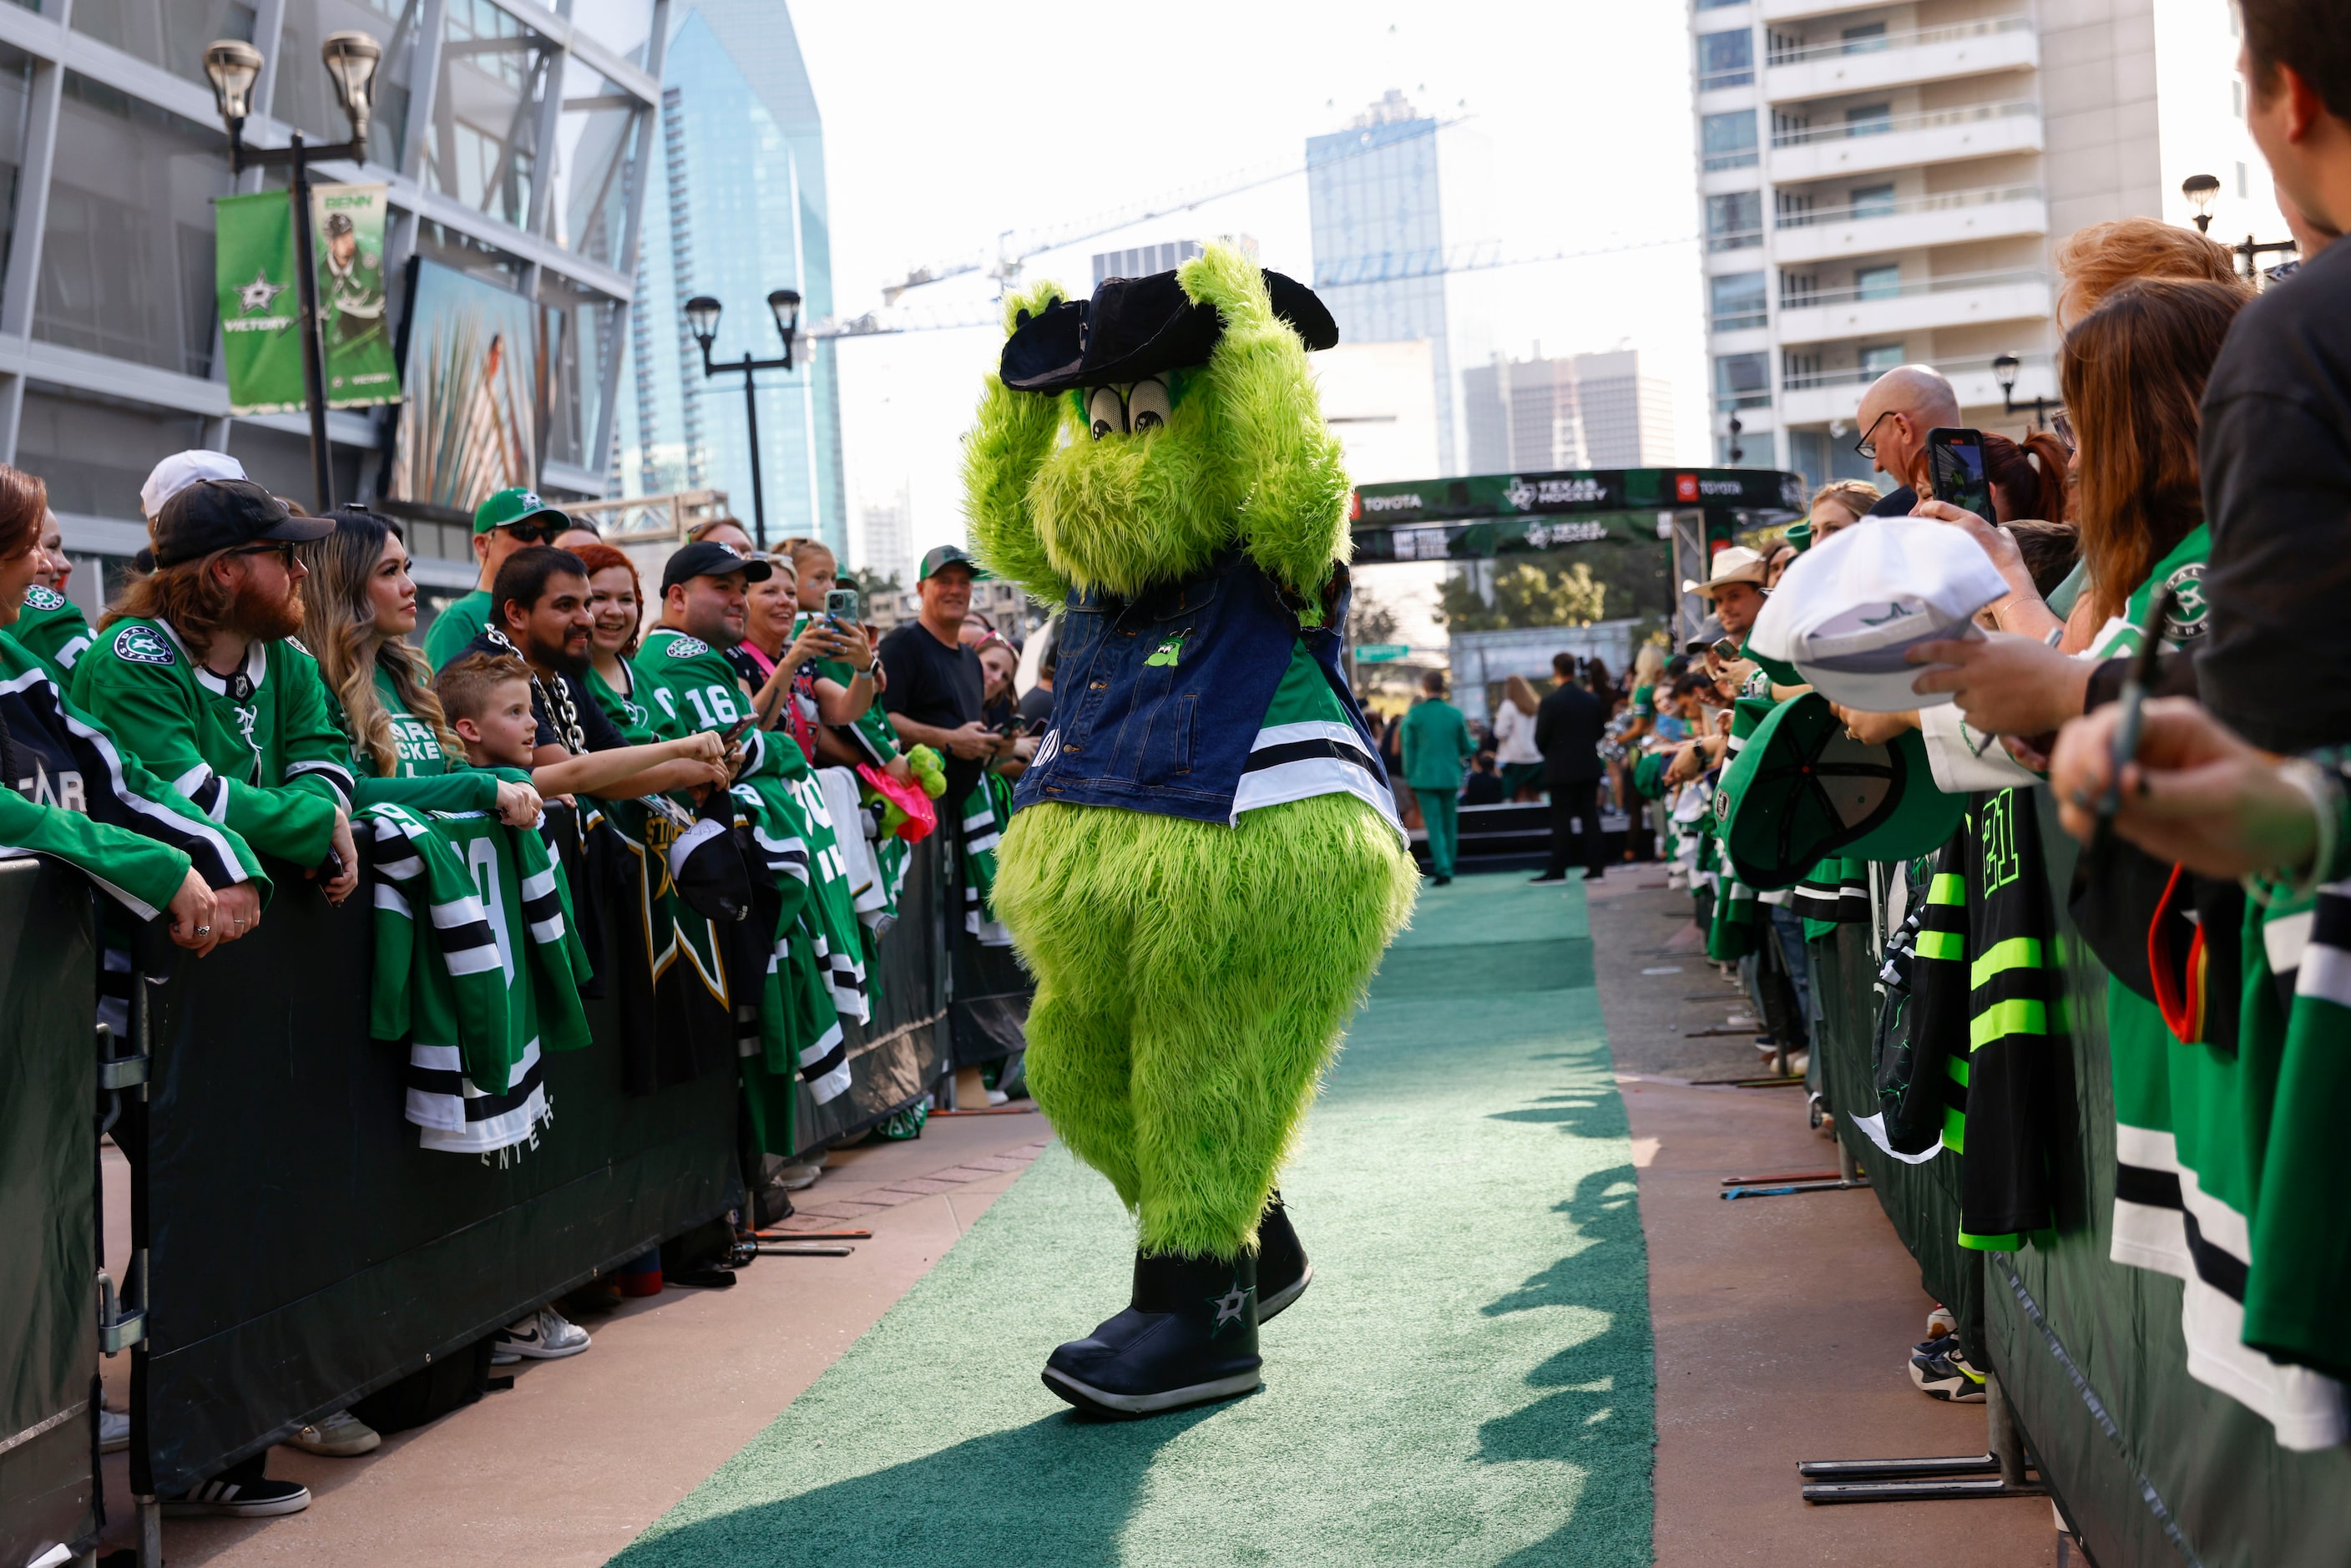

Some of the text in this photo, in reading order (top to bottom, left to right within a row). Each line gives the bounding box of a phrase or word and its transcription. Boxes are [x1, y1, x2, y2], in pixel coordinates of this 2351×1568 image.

[324, 195, 372, 210] BENN
[1537, 478, 1599, 493] TEXAS
[1698, 480, 1743, 495] TOYOTA
[1363, 493, 1423, 512] TOYOTA
[1538, 488, 1608, 503] HOCKEY
[119, 647, 168, 662] STARS
[685, 685, 740, 730] 16
[1982, 787, 2019, 900] 21
